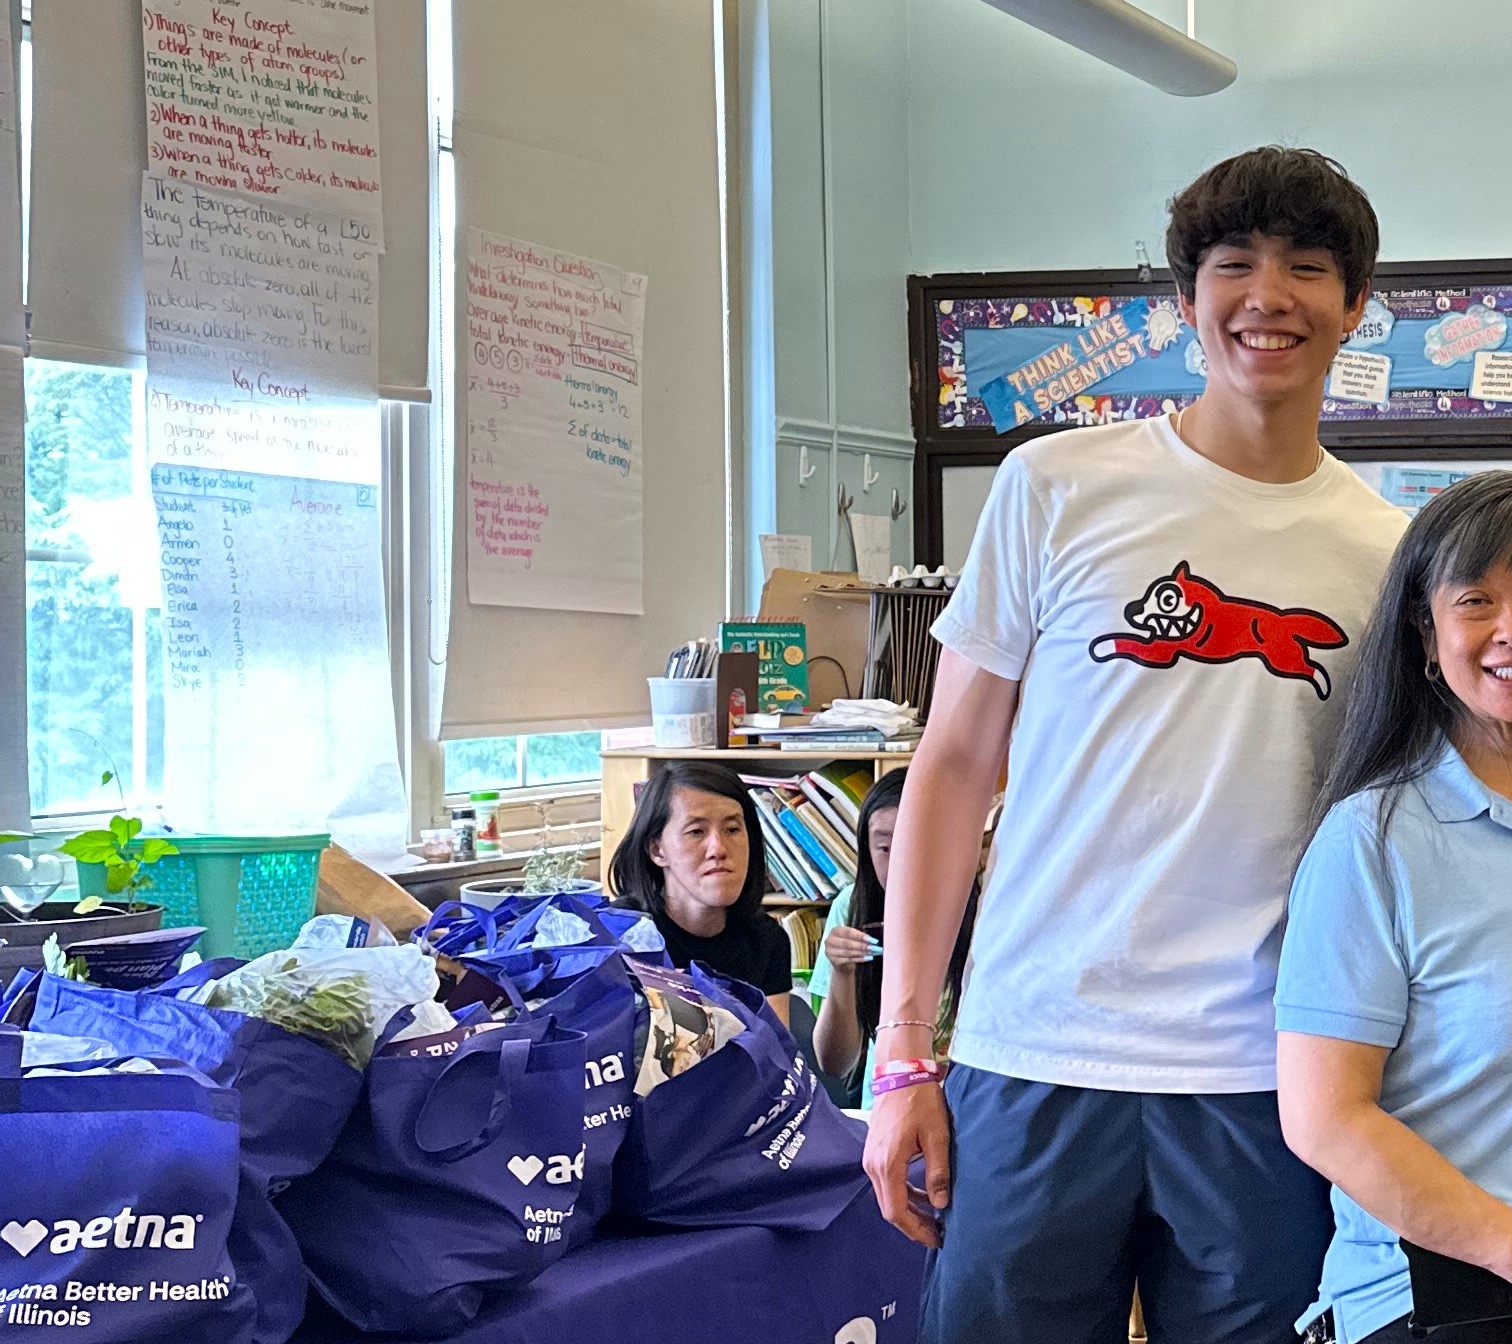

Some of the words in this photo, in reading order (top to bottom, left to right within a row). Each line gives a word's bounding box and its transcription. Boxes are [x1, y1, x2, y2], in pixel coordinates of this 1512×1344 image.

[212, 8, 235, 32] Key
[244, 11, 295, 42] Concept
[158, 36, 193, 57] other
[240, 53, 254, 71] of
[300, 63, 345, 87] groups)
[203, 26, 223, 43] are
[229, 31, 264, 52] made
[268, 39, 282, 57] of
[287, 45, 341, 65] molecules
[147, 70, 184, 88] moved
[189, 75, 222, 96] faster
[183, 56, 204, 75] the
[250, 73, 291, 93] noticed
[296, 79, 320, 97] that
[323, 84, 372, 105] molecules
[163, 127, 184, 141] are
[189, 132, 235, 160] moving
[210, 117, 243, 148] thing
[248, 124, 272, 148] gets
[148, 177, 184, 204] The
[192, 188, 286, 227] temperature
[294, 215, 310, 232] of
[144, 204, 182, 238] thing
[190, 210, 252, 238] depends
[258, 227, 277, 240] on
[282, 231, 310, 249] how
[317, 238, 344, 256] fast
[190, 236, 210, 253] its
[220, 244, 294, 269] molecules
[1435, 289, 1466, 297] Method
[469, 321, 491, 340] total
[1007, 342, 1078, 396] THINK
[1076, 313, 1130, 356] LIKE
[258, 372, 311, 400] Concept
[1013, 401, 1034, 426] A
[1033, 332, 1148, 412] SCIENTIST
[759, 664, 783, 674] UIZ
[762, 1128, 791, 1160] Aetna
[779, 1153, 791, 1170] of
[50, 1207, 196, 1254] aetna
[527, 1226, 541, 1242] of
[65, 1281, 143, 1302] Better
[150, 1278, 229, 1300] Health
[8, 1305, 91, 1326] Illinois
